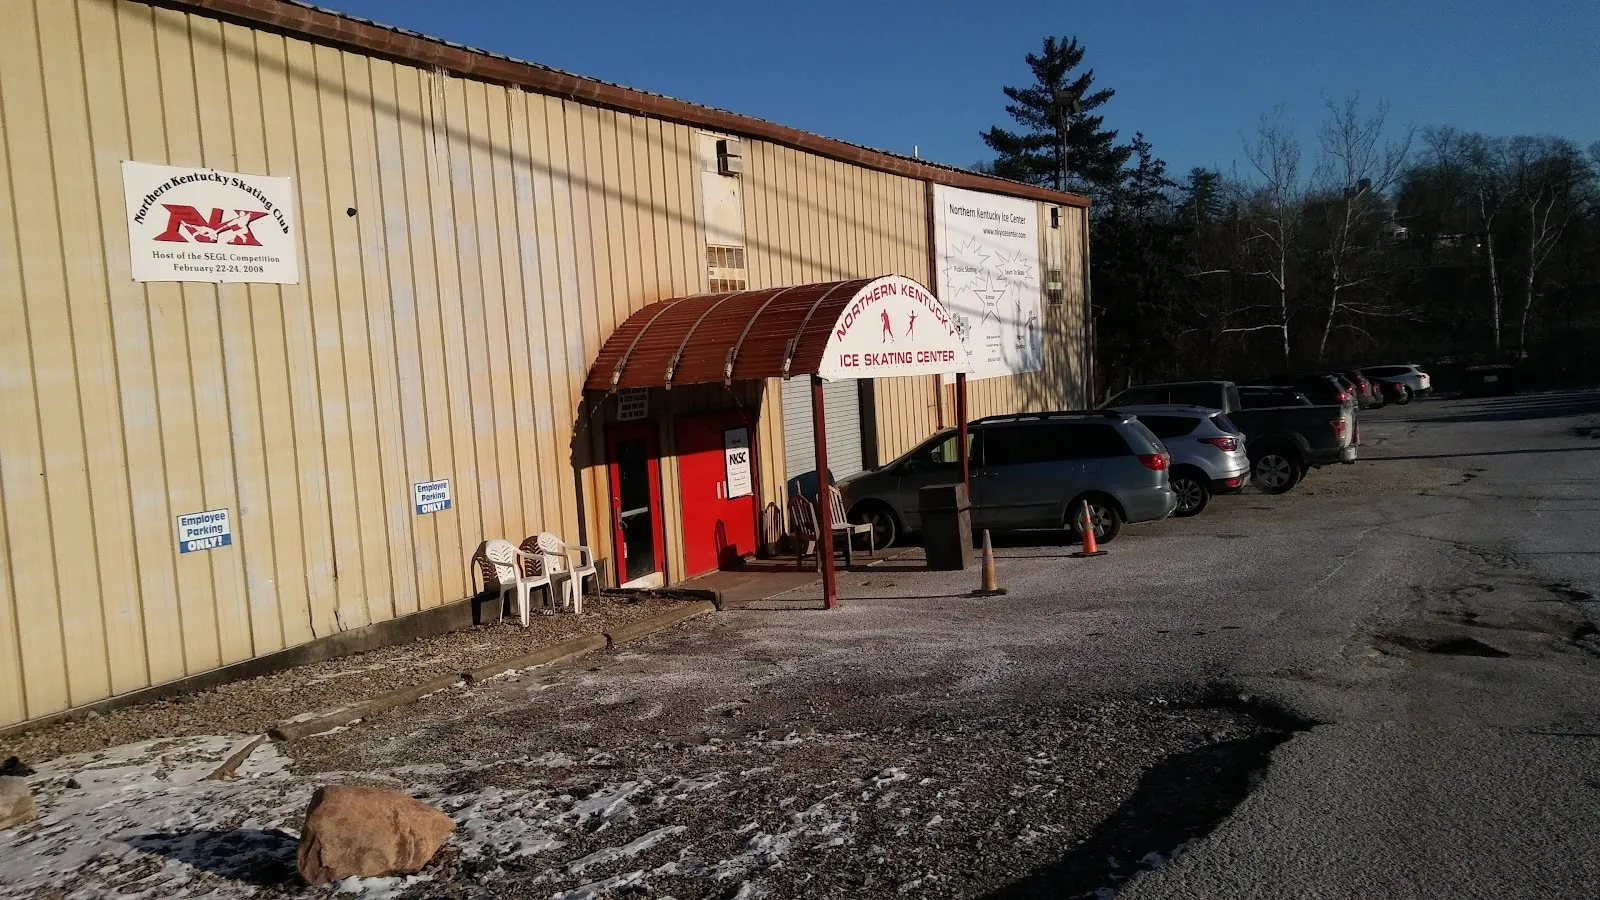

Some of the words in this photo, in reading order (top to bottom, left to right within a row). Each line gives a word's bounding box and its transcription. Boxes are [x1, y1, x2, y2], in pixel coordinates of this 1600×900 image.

[134, 181, 172, 225] Northern
[170, 172, 230, 188] Kentucky
[231, 177, 273, 211] Skating
[272, 208, 289, 235] Club
[949, 203, 976, 218] Northern
[976, 207, 1001, 223] Kentucky
[1001, 211, 1009, 223] Ice
[1009, 213, 1026, 225] Center
[152, 251, 175, 260] Host
[176, 251, 186, 260] of
[187, 252, 202, 260] the
[204, 252, 228, 261] SEGL
[229, 253, 280, 263] Competition
[173, 263, 214, 274] February
[243, 265, 264, 273] 2008
[953, 265, 964, 273] Public
[964, 266, 978, 274] Skating
[836, 283, 897, 342] NORTHERN
[901, 283, 956, 337] KENTUCKY
[839, 353, 860, 368] ICE
[864, 351, 913, 366] SKATING
[916, 350, 955, 363] CENTER
[729, 451, 746, 466] NKSC
[416, 482, 448, 493] Employee
[421, 492, 446, 502] Parking
[421, 500, 446, 514] ONLY!
[181, 512, 226, 527] Employee
[187, 524, 223, 537] Parking
[187, 536, 223, 551] ONLY!
